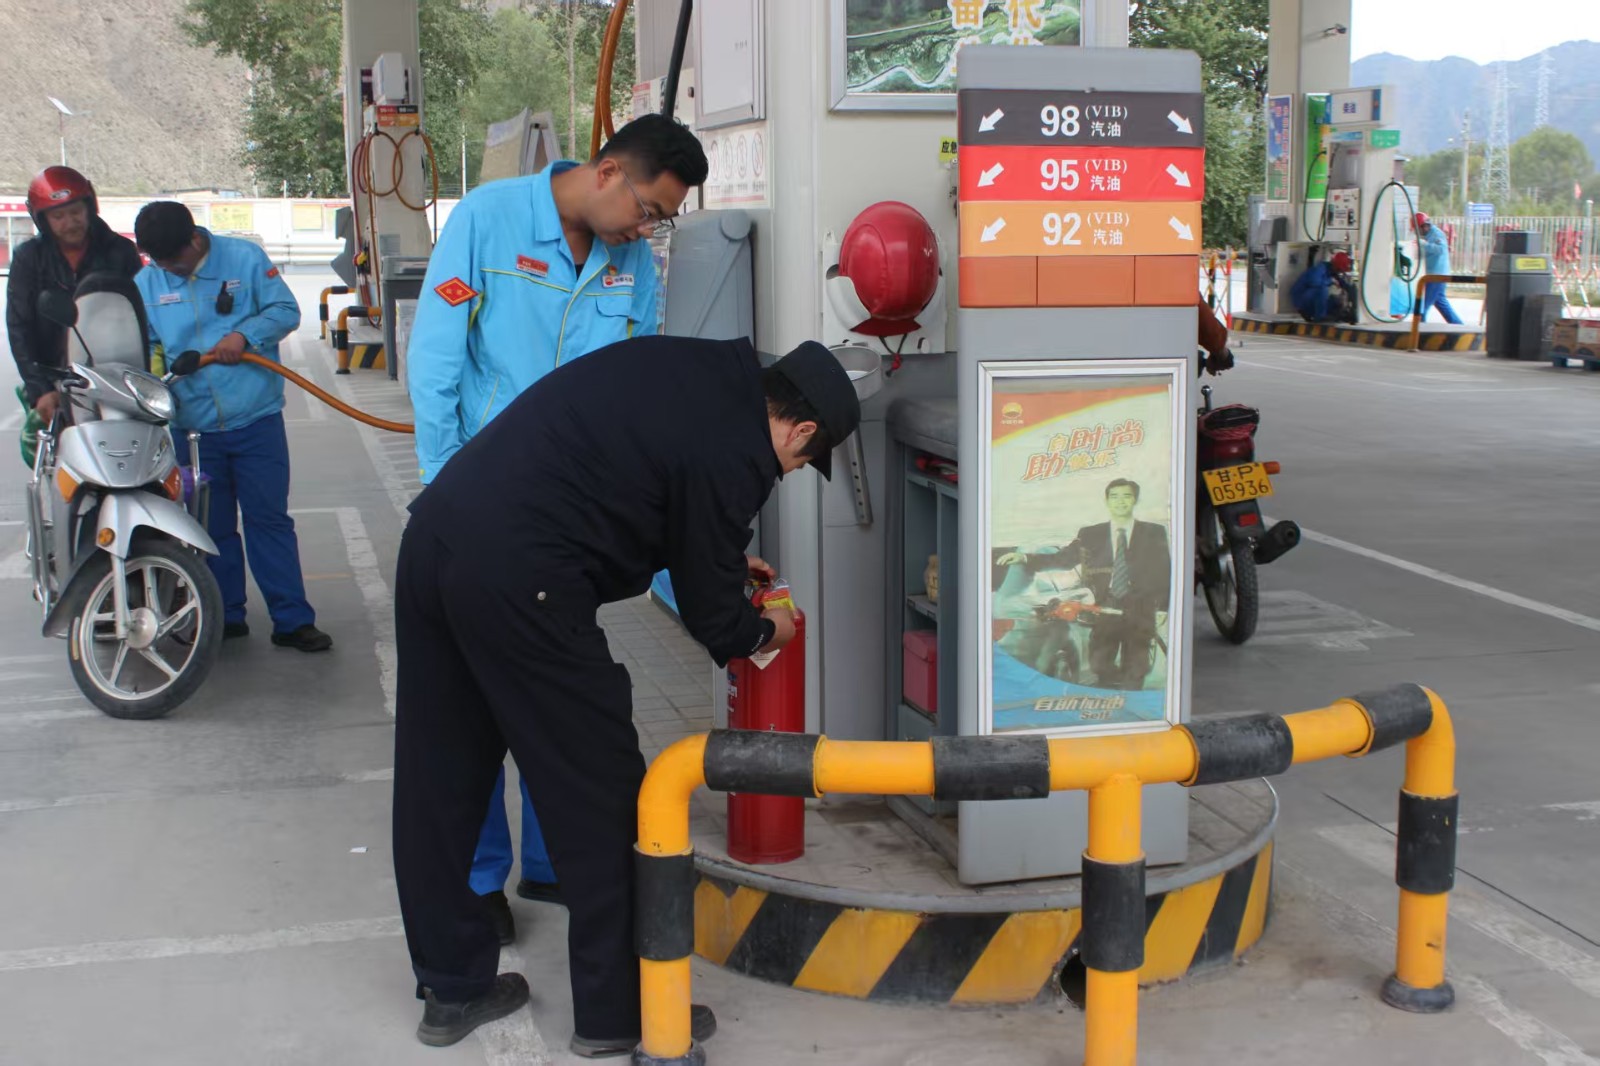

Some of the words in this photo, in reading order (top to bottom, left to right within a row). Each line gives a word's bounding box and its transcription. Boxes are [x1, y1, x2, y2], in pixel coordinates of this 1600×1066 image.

[1040, 105, 1080, 137] 98
[1084, 104, 1128, 120] (VIB)
[1090, 121, 1122, 138] 汽油
[1040, 159, 1080, 191] 95
[1084, 158, 1128, 174] (VIB)
[1090, 175, 1121, 191] 汽油
[1042, 212, 1081, 246] 92
[1086, 211, 1130, 227] (VIB)
[1093, 229, 1123, 246] 汽油
[1212, 479, 1269, 502] 05936
